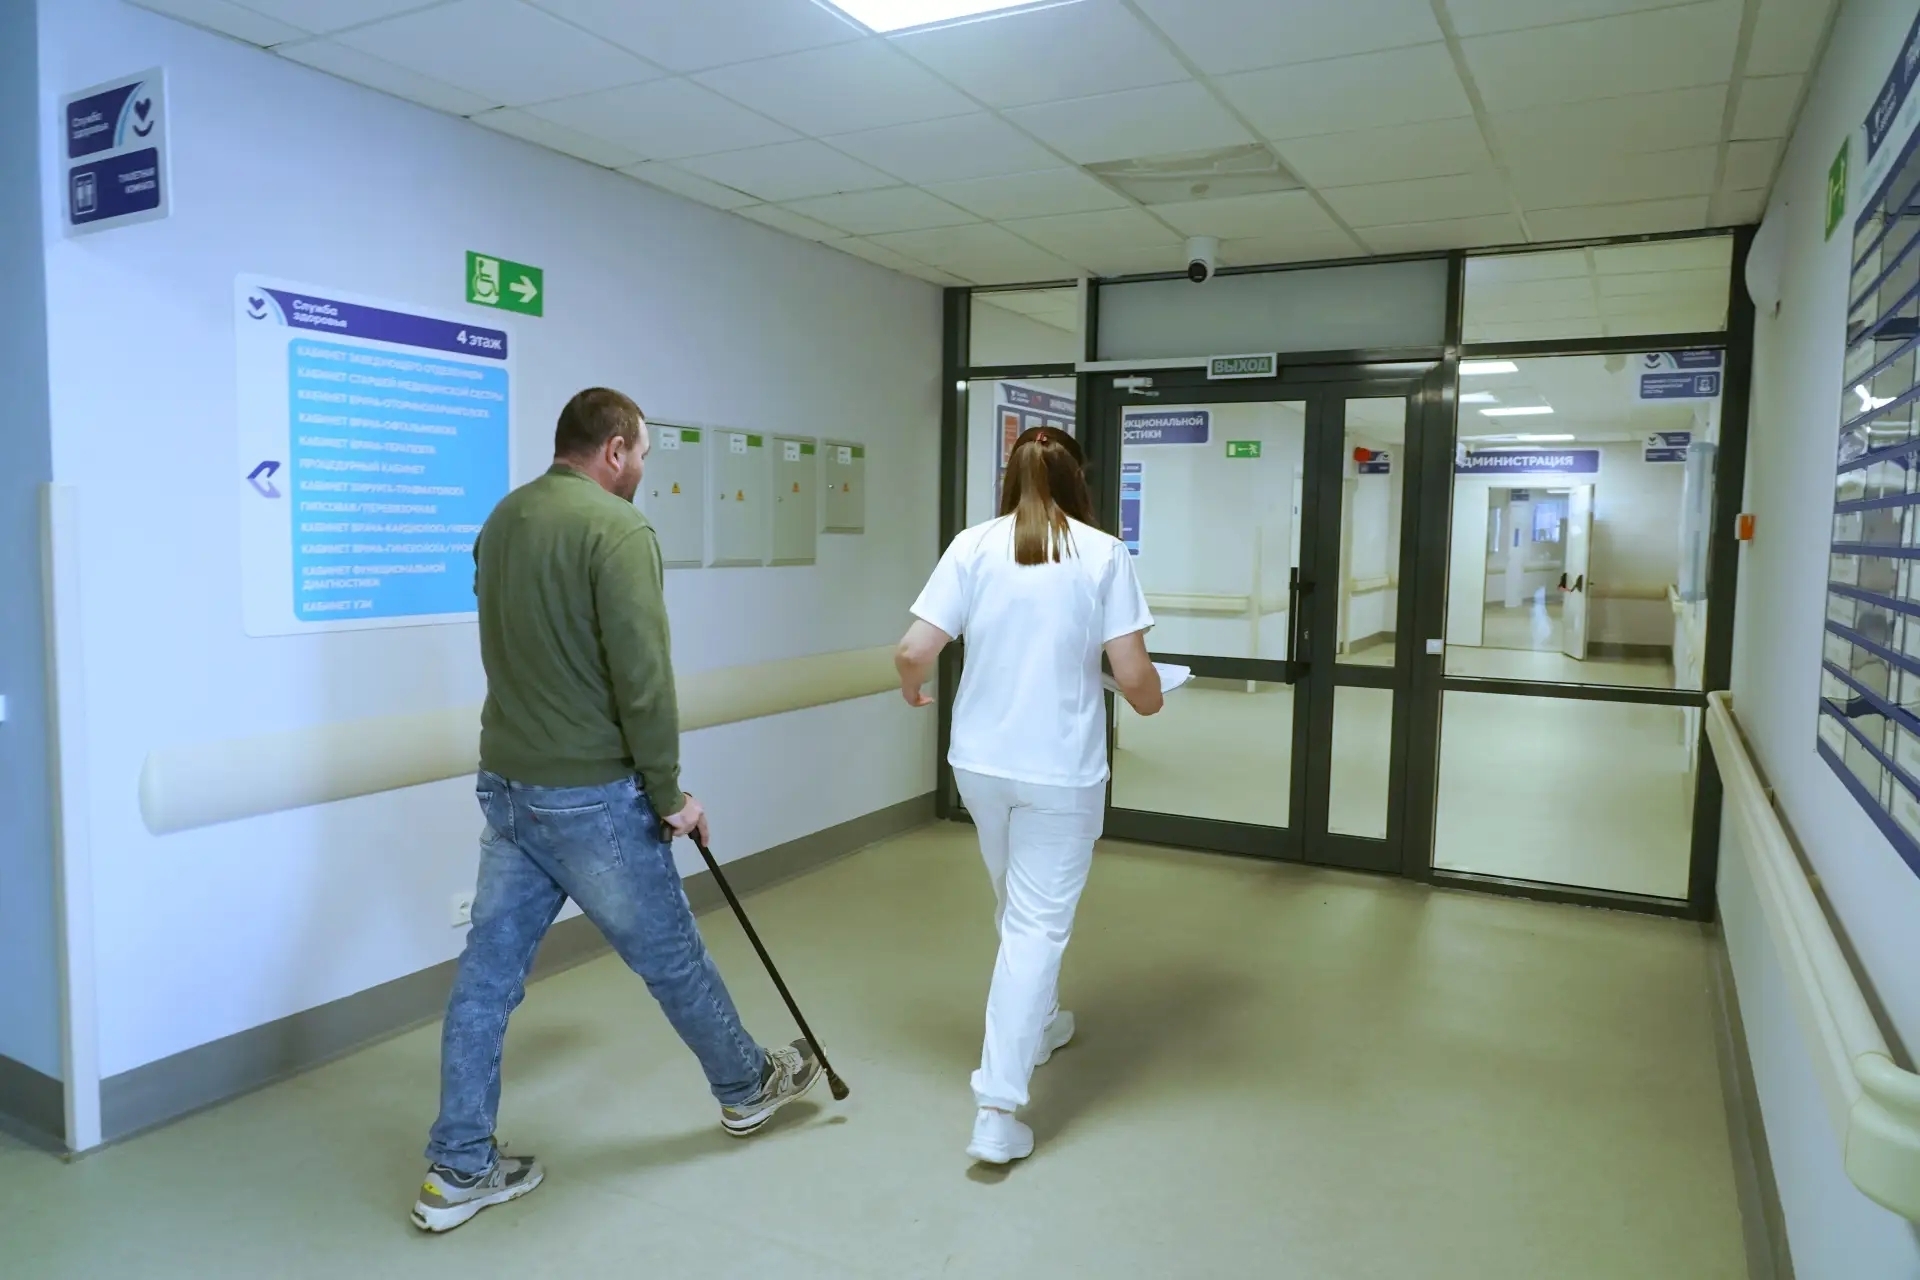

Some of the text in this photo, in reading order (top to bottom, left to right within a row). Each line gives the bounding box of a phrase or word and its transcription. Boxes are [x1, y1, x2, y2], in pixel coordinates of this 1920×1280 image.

[292, 300, 338, 316] Служба
[292, 312, 348, 328] здоровья
[456, 330, 502, 350] 4 этаж
[1214, 359, 1270, 373] ВЫХОД
[1457, 455, 1574, 468] ДМИНИСТРАЦИЯ
